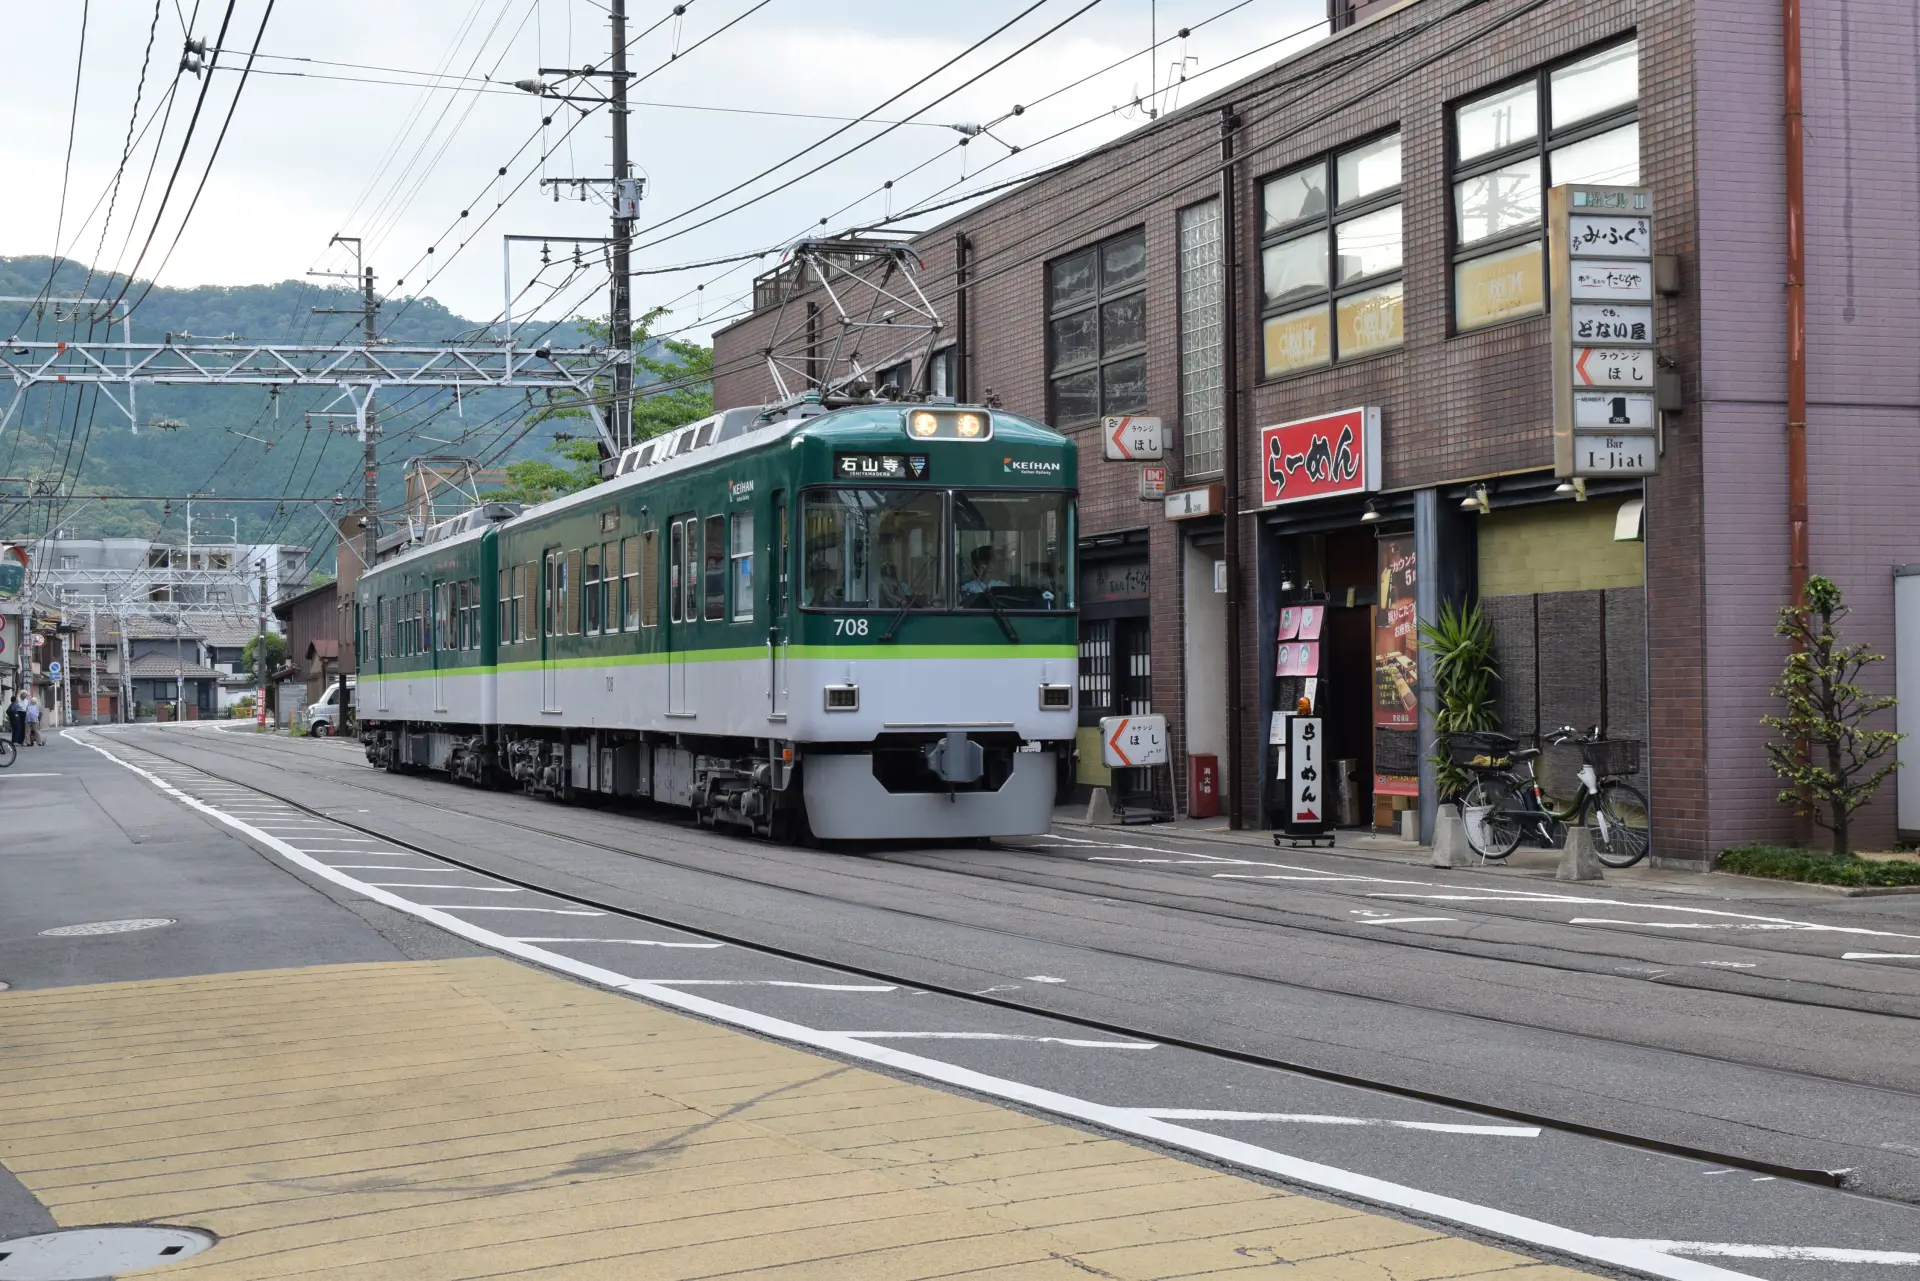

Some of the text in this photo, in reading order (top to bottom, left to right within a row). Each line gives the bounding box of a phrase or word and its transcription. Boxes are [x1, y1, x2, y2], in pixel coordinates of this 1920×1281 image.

[1578, 320, 1646, 340] どない屋
[1600, 352, 1641, 361] ラウンジ
[1608, 367, 1644, 381] ほし
[1134, 438, 1158, 452] ほし
[1606, 439, 1623, 449] Bar
[841, 457, 899, 472] 石山寺
[1012, 461, 1060, 470] KEIHAN
[1268, 424, 1360, 497] らーめん
[1588, 452, 1643, 469] I-Jiat
[733, 480, 754, 496] KEIHAN
[833, 618, 869, 636] 708
[1130, 734, 1160, 746] ほし
[1300, 722, 1317, 803] らーめん
[1203, 767, 1211, 793] 消火器
